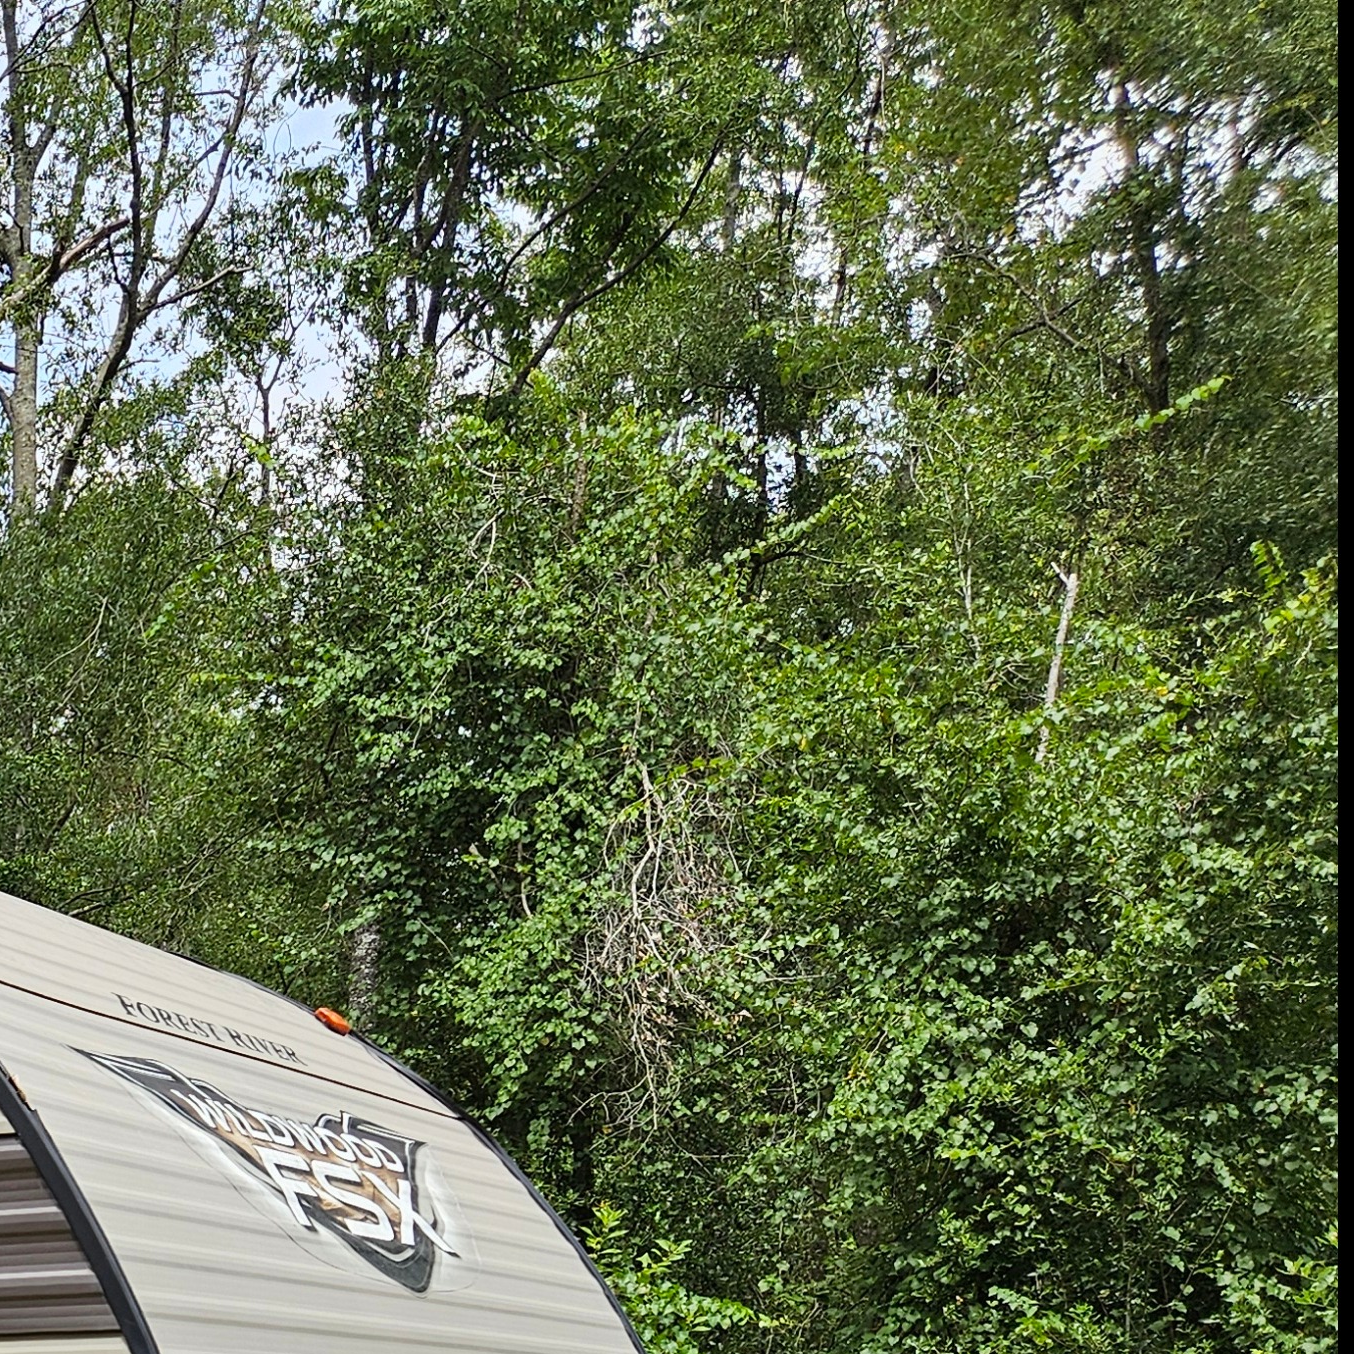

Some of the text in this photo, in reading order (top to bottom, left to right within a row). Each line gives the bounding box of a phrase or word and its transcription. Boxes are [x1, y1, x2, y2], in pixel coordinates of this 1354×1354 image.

[110, 991, 309, 1067] FOREST RIVER
[169, 1088, 405, 1173] WILDWOOD
[254, 1144, 461, 1258] FSX
